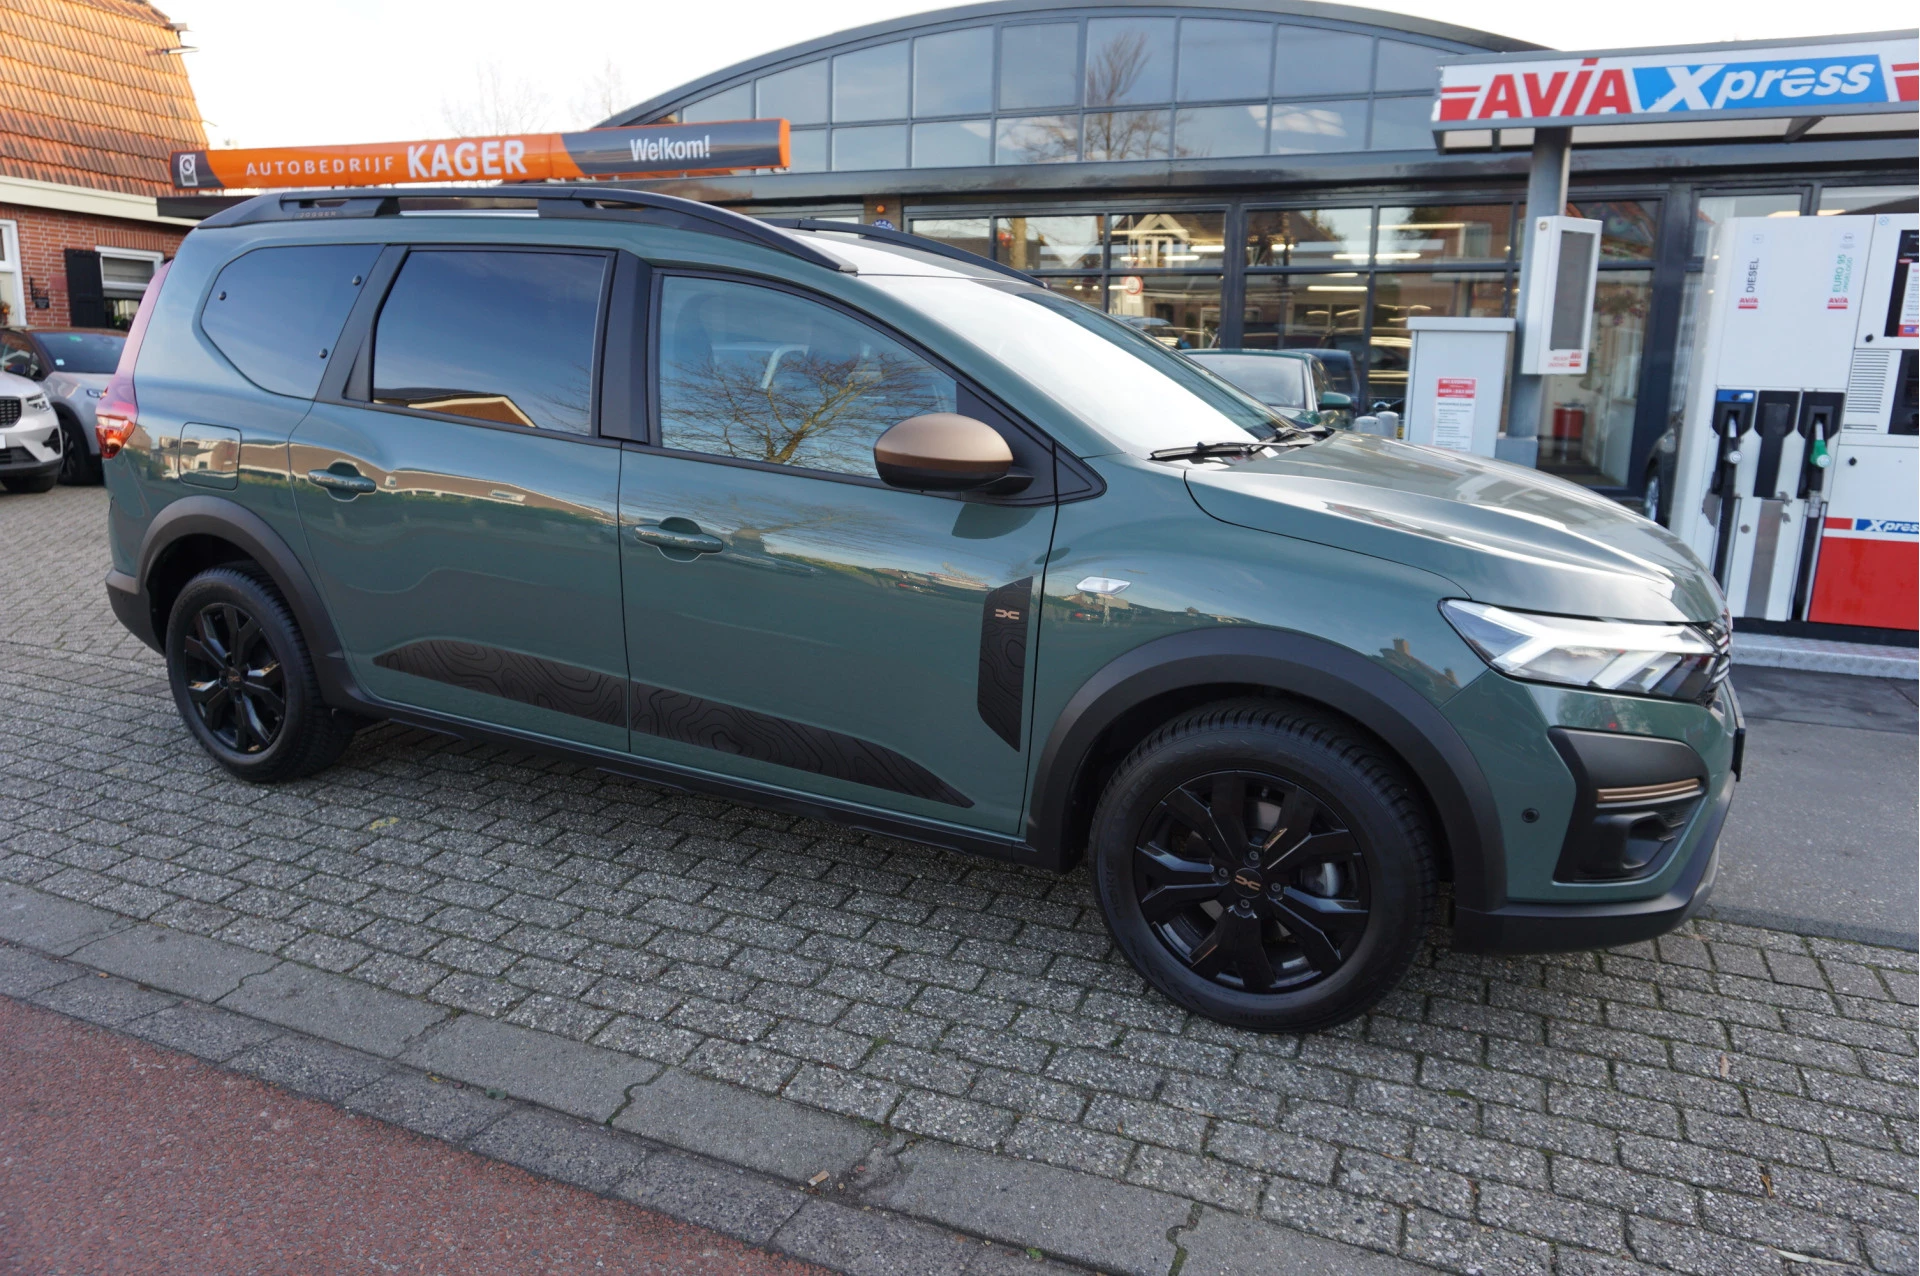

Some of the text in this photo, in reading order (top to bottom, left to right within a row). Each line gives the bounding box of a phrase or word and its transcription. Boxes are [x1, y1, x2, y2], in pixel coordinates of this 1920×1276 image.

[1477, 57, 1875, 119] AVIA Xpress
[246, 140, 527, 178] AUTOBEDRIJF KAGER
[630, 135, 710, 162] Welkom!
[1746, 257, 1759, 293] DIESEL
[1832, 254, 1847, 293] EURO 95
